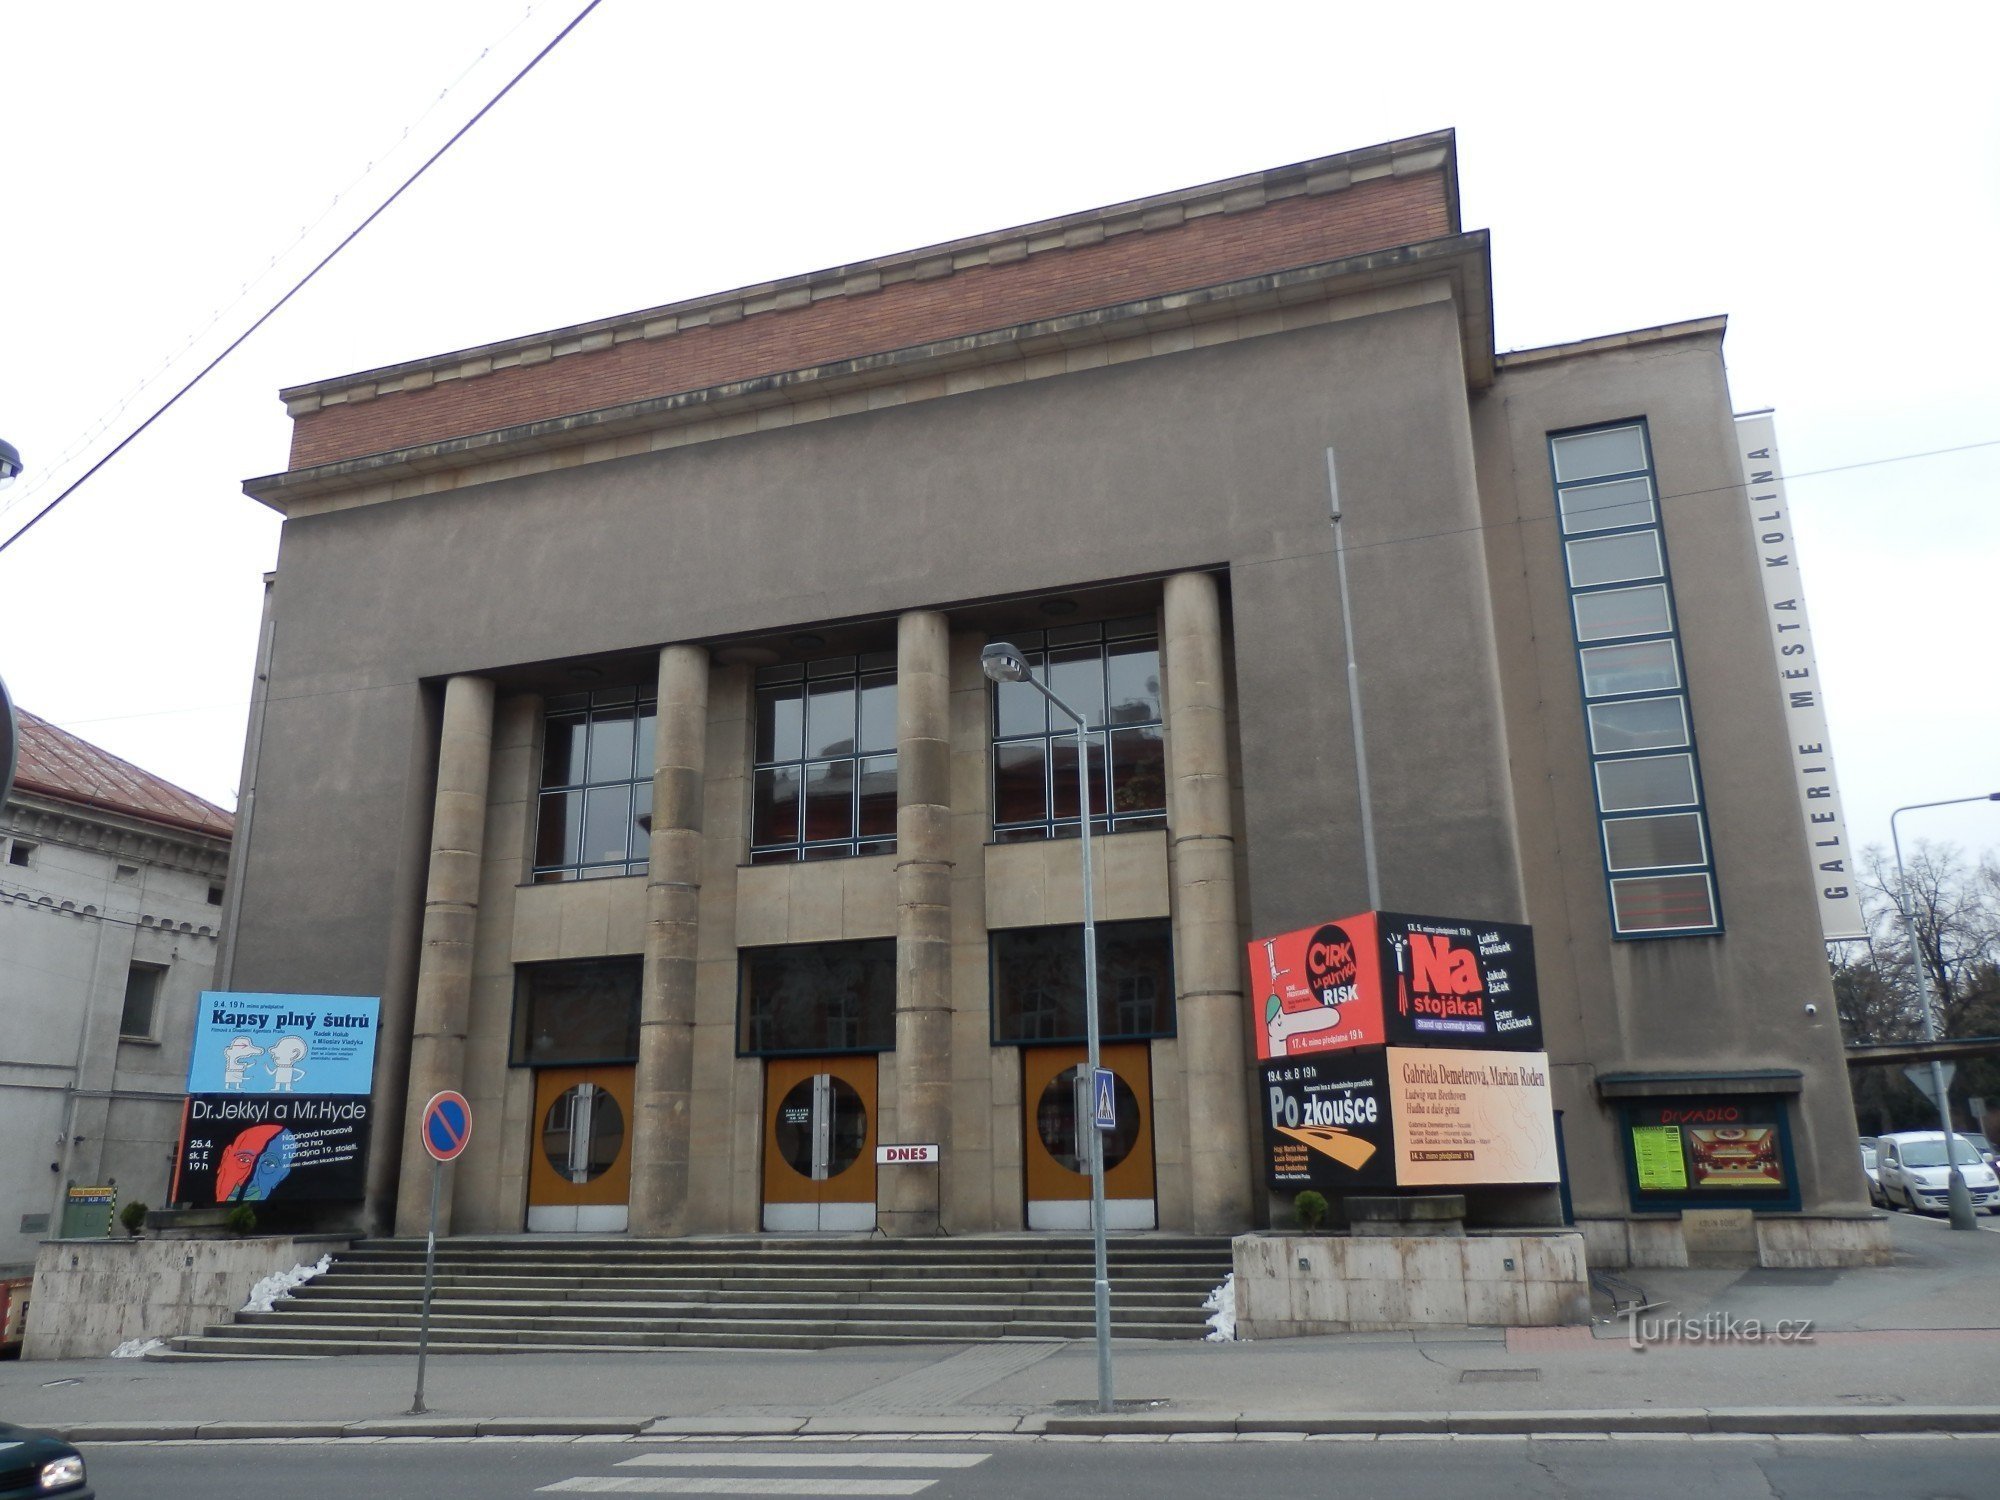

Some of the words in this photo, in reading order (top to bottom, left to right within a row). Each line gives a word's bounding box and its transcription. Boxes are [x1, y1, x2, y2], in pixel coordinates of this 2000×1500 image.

[1747, 448, 1788, 567] KOLÍNA
[1773, 599, 1814, 708] MĚSTA
[1799, 743, 1849, 899] GALERIE
[1477, 932, 1499, 944] Lukáš
[1480, 942, 1511, 955] Pavlásek
[1309, 942, 1352, 975] CIRK
[1408, 933, 1483, 995] Na
[1323, 962, 1356, 989] PUTYKA
[1486, 969, 1507, 981] Jakub
[1323, 984, 1359, 1006] RISK
[1488, 982, 1510, 994] Žáček
[1414, 996, 1482, 1017] stojáka!
[212, 1010, 269, 1029] Kapsy
[276, 1012, 316, 1030] plný
[323, 1013, 369, 1028] šutrů
[1494, 1010, 1513, 1020] Ester
[1418, 1020, 1434, 1029] Stand
[1435, 1022, 1442, 1030] up
[1444, 1021, 1465, 1030] comedy
[1292, 1038, 1301, 1049] 17.
[1302, 1038, 1308, 1047] 4.
[1349, 1030, 1356, 1040] 19
[1357, 1029, 1363, 1038] h
[1268, 1071, 1282, 1081] 19.4.
[1285, 1070, 1293, 1080] sk.
[1303, 1067, 1310, 1078] 19
[1312, 1067, 1316, 1077] h
[1403, 1063, 1438, 1084] Gabriela
[1439, 1065, 1489, 1087] Demeterová,
[1490, 1066, 1519, 1086] Marian
[1519, 1067, 1545, 1087] Roden
[1405, 1089, 1425, 1101] Ludwig
[1427, 1092, 1437, 1100] van
[1438, 1089, 1466, 1100] Beethoven
[192, 1101, 269, 1122] Dr.Jekkyl
[274, 1105, 288, 1119] a
[293, 1101, 366, 1122] Mr.Hyde
[1270, 1086, 1299, 1128] Po
[1303, 1090, 1377, 1125] zkoušce
[1406, 1103, 1424, 1114] Hudba
[1662, 1107, 1738, 1123] DIVADLO
[282, 1131, 319, 1141] Napínavá
[191, 1140, 213, 1148] 25.4.
[289, 1149, 320, 1159] Londýna
[886, 1148, 927, 1161] DNES
[189, 1162, 200, 1170] 19
[202, 1162, 208, 1170] h
